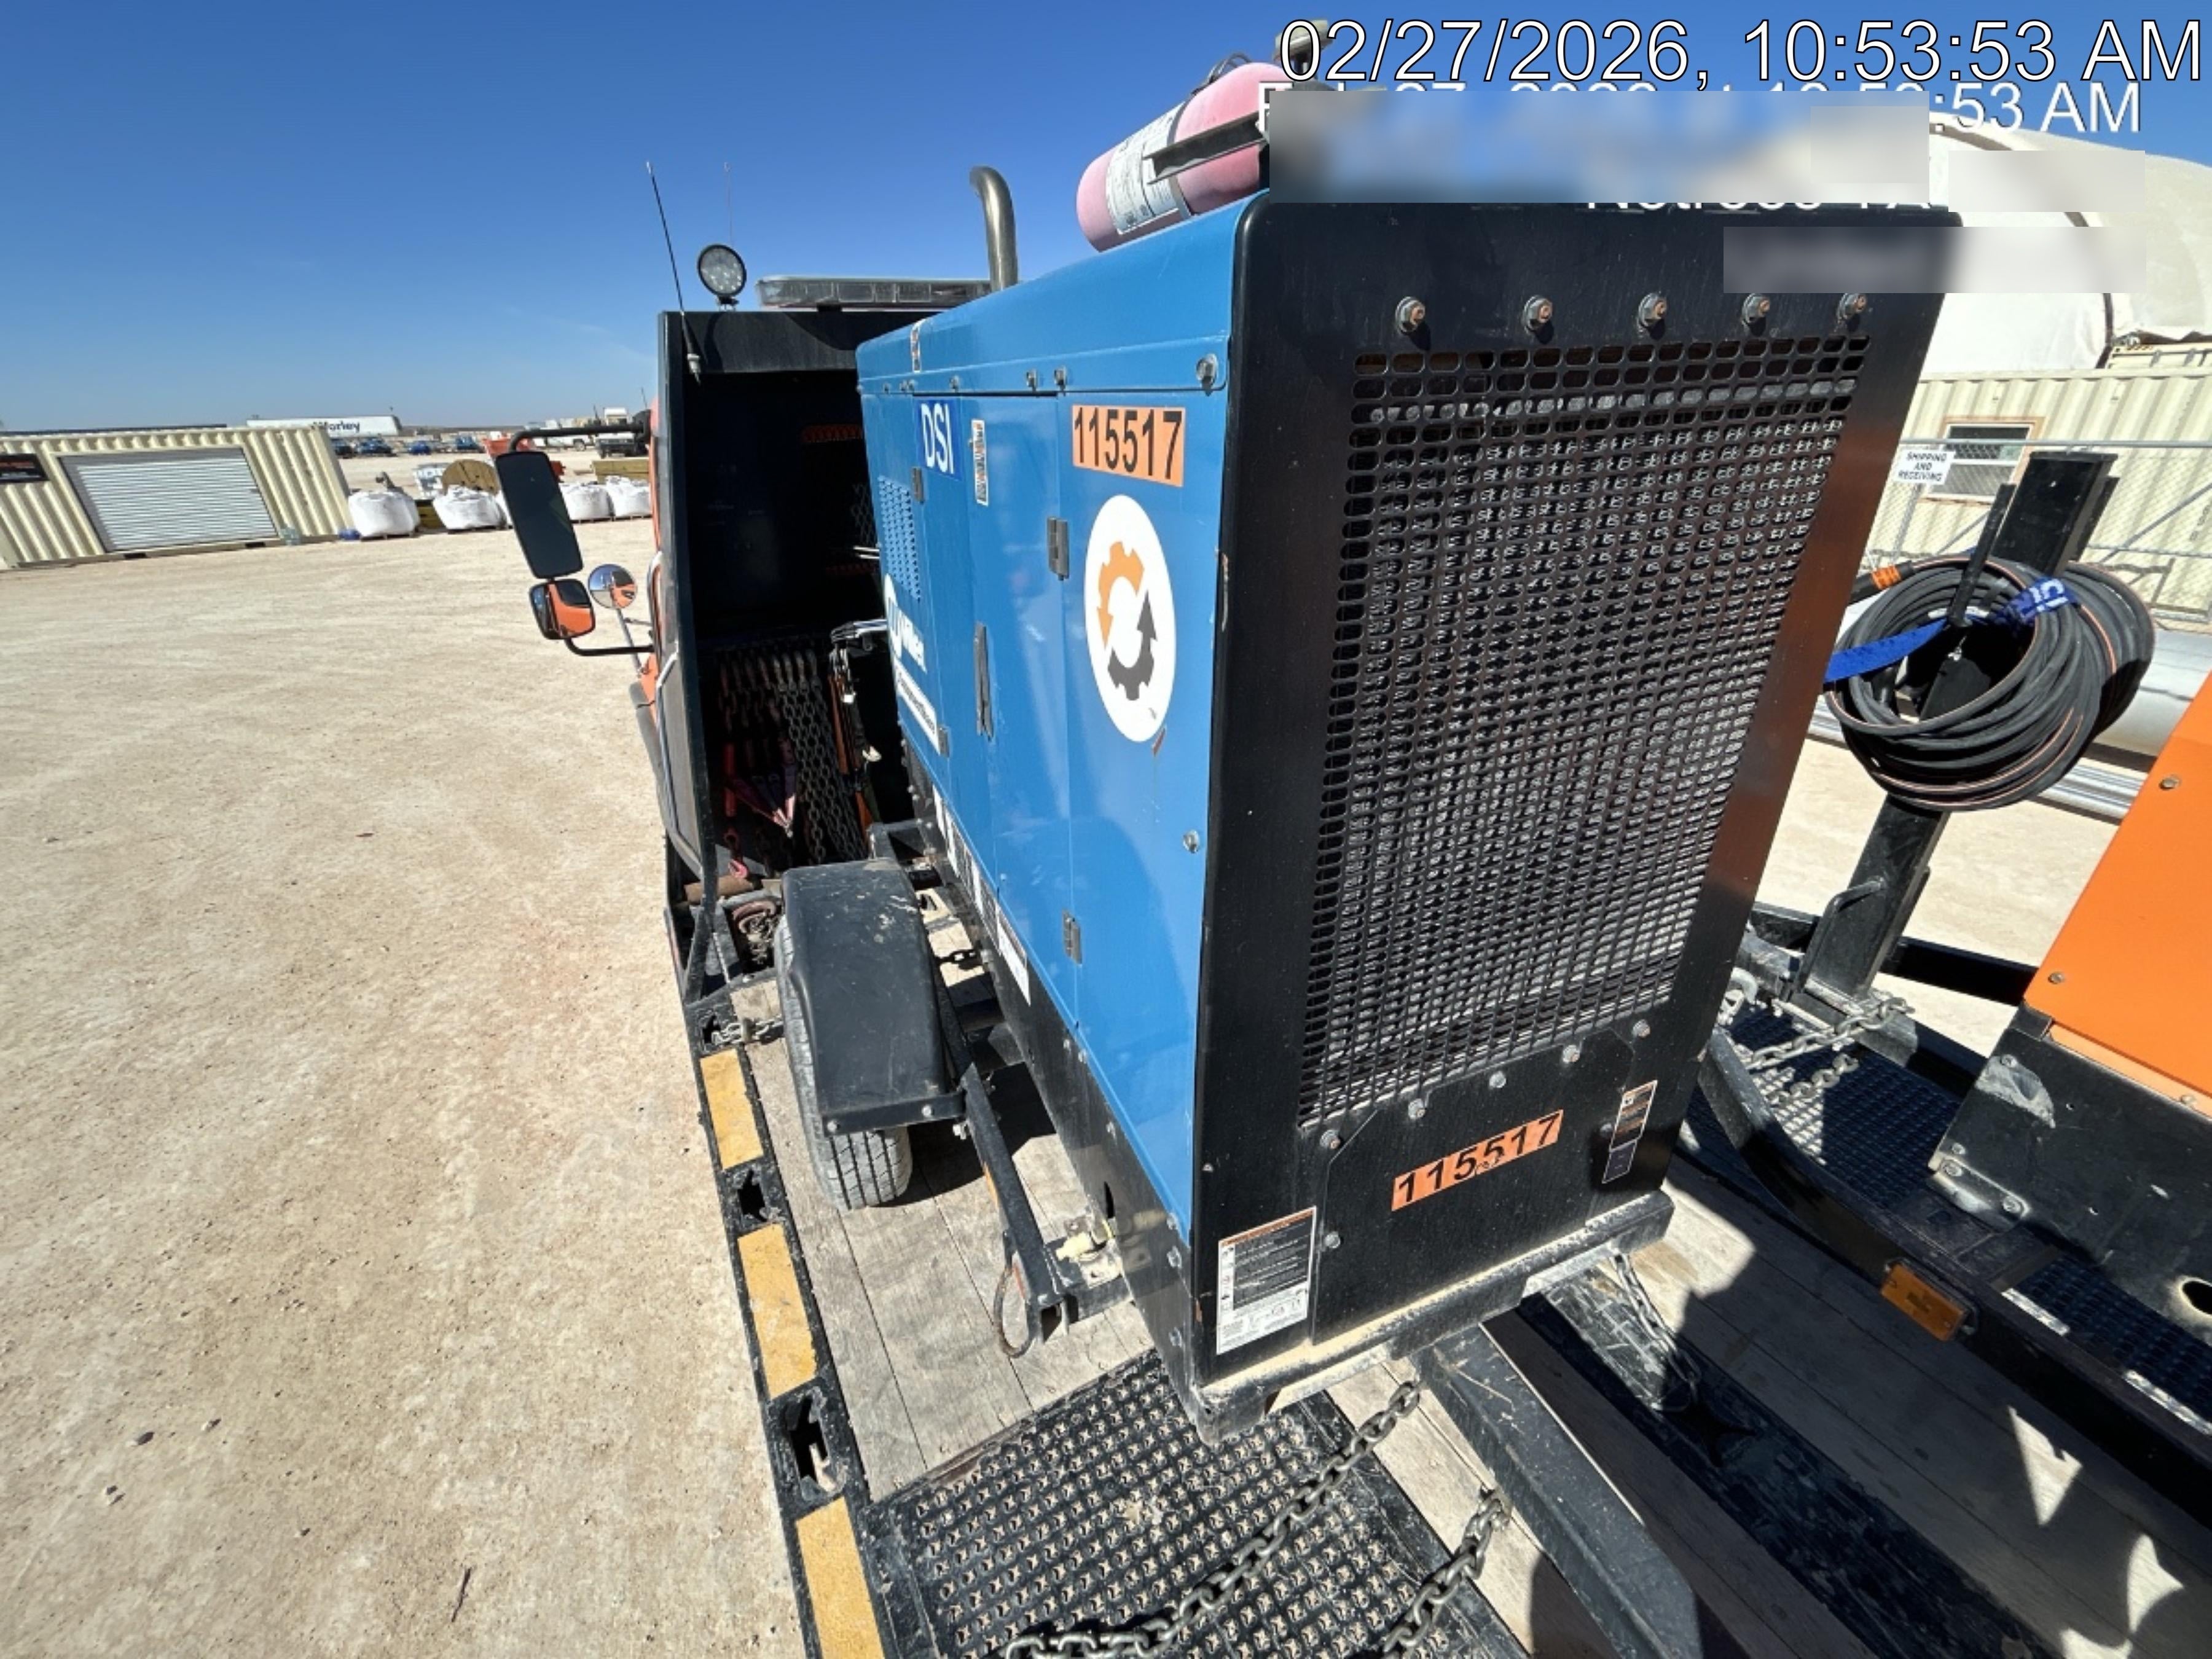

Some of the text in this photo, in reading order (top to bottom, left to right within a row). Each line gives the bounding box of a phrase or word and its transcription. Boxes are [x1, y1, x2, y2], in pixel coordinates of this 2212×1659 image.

[921, 402, 954, 474] DSI
[1075, 406, 1183, 480] 115517
[1907, 451, 1947, 462] SHIPPING
[1898, 470, 1943, 481] RECEIVING
[1914, 461, 1932, 471] AND
[1398, 1113, 1560, 1202] 115517
